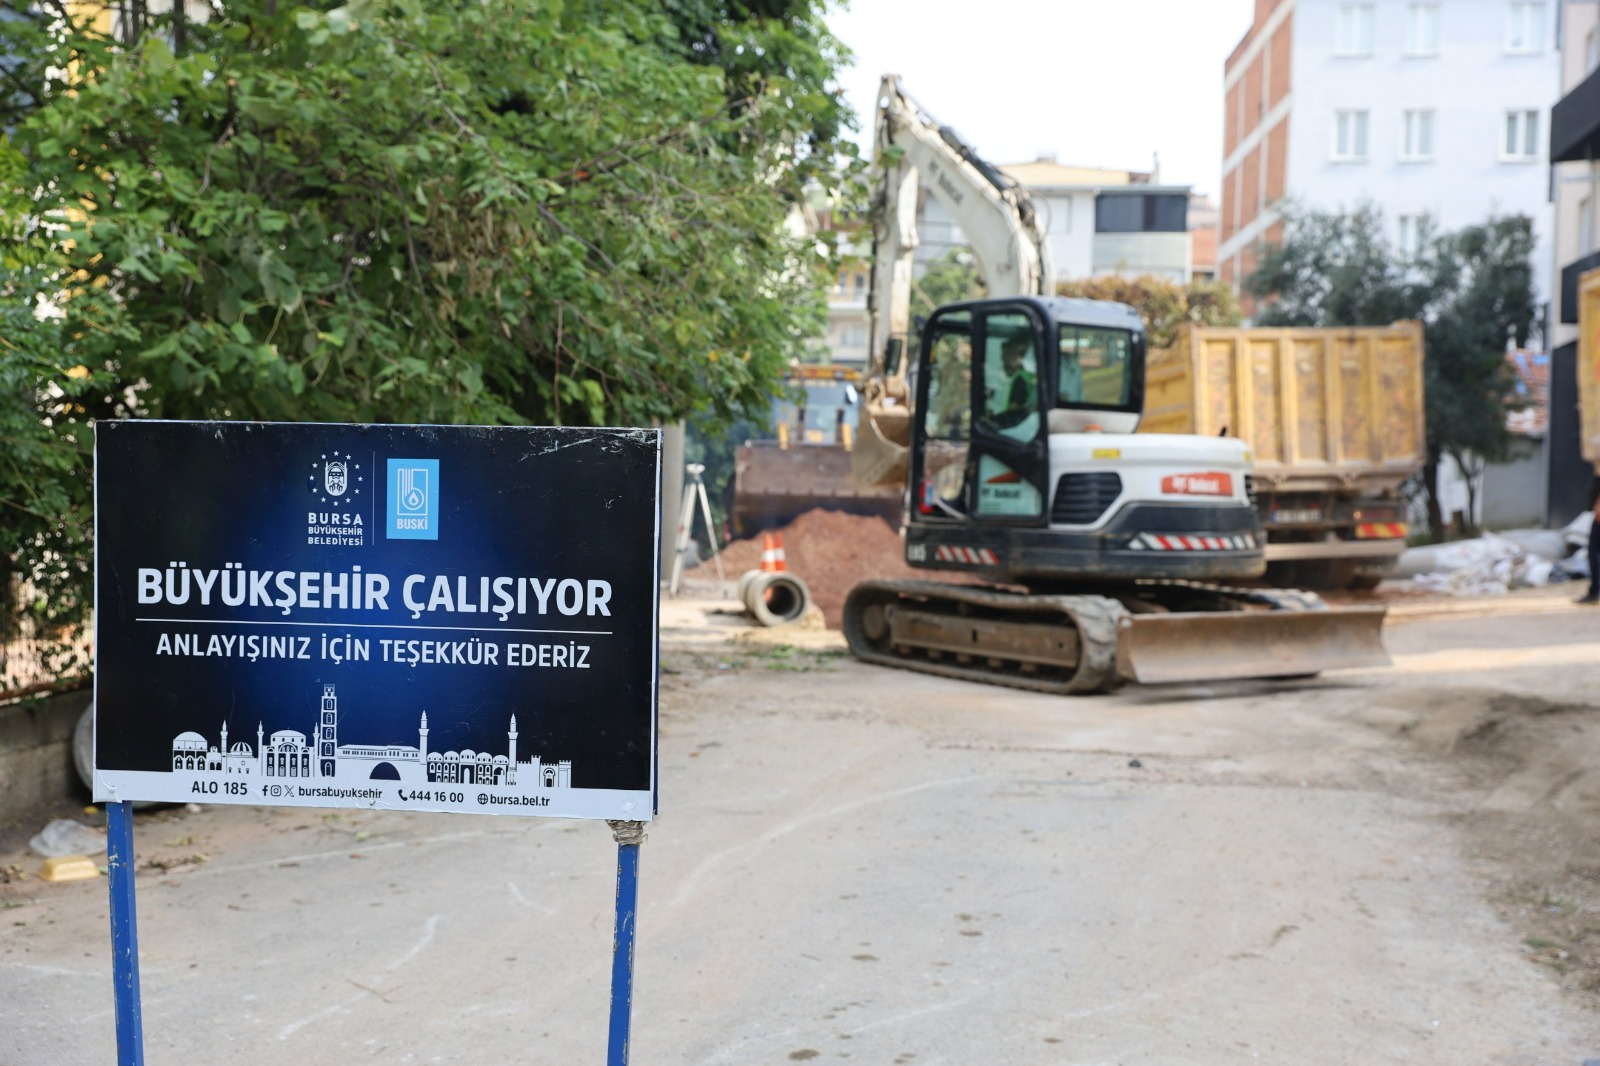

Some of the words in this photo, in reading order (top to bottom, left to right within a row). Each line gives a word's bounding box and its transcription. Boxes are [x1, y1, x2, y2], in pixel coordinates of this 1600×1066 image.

[307, 512, 363, 526] BURSA
[396, 517, 428, 530] BUSKİ
[307, 525, 363, 538] BÜYÜKŞEHİR
[307, 535, 363, 546] BELEDİYESİ
[137, 561, 390, 616] BÜYÜKŞEHİR
[402, 573, 612, 622] ÇALIŞIYOR
[156, 633, 311, 663] ANLAYIŞINIZ
[321, 633, 370, 665] İÇİN
[379, 638, 499, 668] TEŞEKKÜR
[507, 640, 591, 669] EDERİZ
[191, 780, 219, 794] ALO
[223, 781, 248, 796] 185
[298, 786, 383, 799] bursabuyuksehir
[409, 790, 431, 802] 444
[434, 791, 447, 802] 16
[449, 792, 464, 803] 00
[490, 793, 551, 807] bursa.bel.tr
